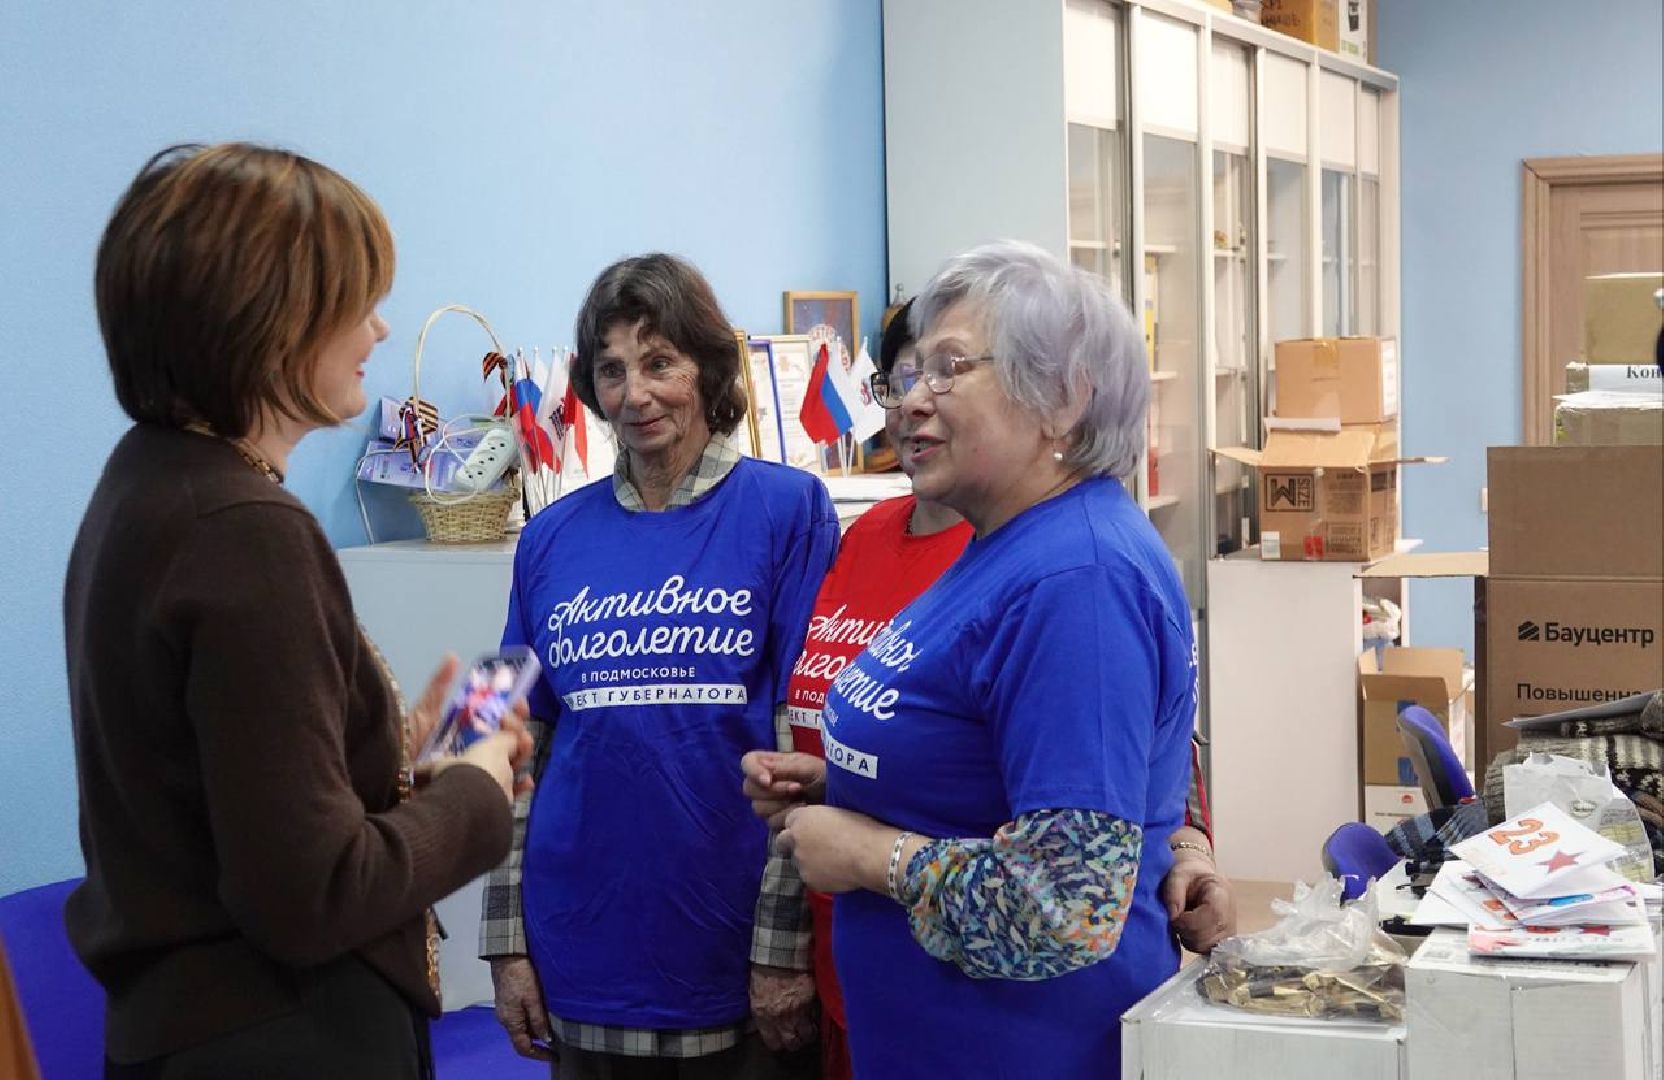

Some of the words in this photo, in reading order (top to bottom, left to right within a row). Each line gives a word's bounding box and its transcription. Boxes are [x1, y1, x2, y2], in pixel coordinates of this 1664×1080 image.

[548, 574, 752, 632] Активное
[549, 625, 755, 668] долголетие
[1545, 622, 1654, 648] Бауцентр
[590, 666, 696, 682] ПОДМОСКОВЬЕ
[608, 687, 745, 702] ГУБЕРНАТОРА
[1488, 818, 1560, 856] 23
